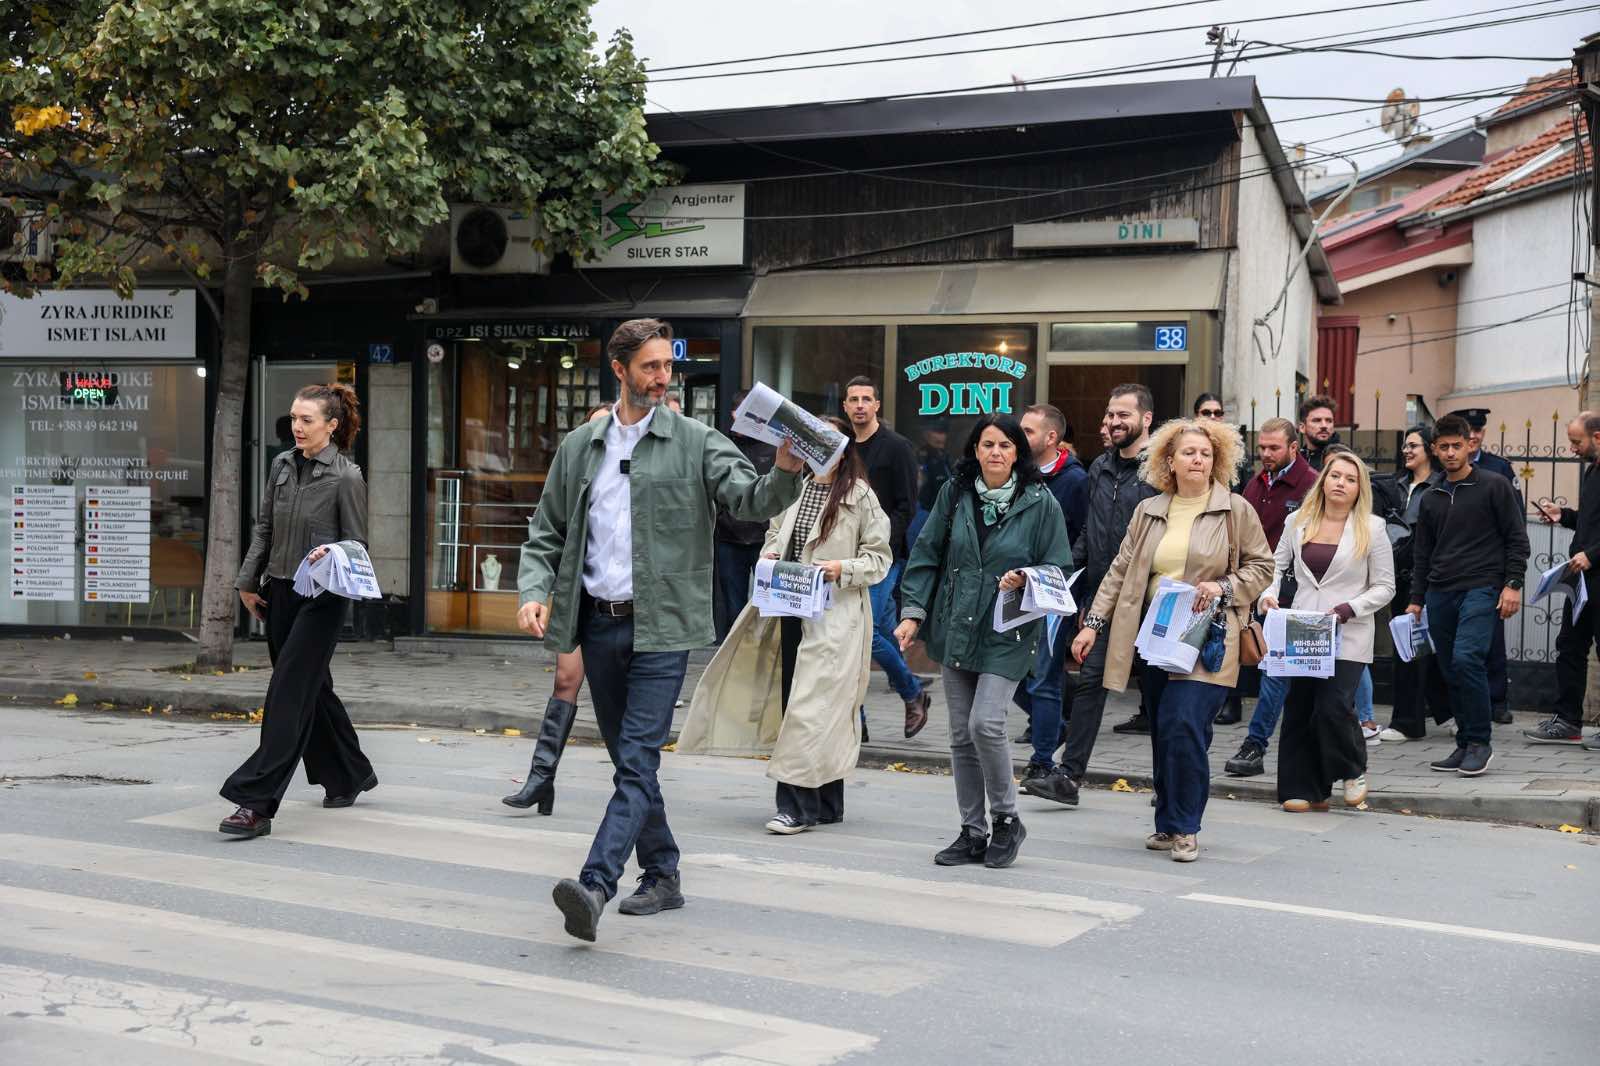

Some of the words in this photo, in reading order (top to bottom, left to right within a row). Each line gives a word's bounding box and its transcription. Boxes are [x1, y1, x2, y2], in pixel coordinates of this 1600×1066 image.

[671, 194, 735, 207] Argjentar
[1117, 223, 1163, 240] DINI
[627, 247, 671, 259] SILVER
[675, 246, 708, 258] STAR
[41, 305, 87, 319] ZYRA
[91, 304, 174, 319] JURIDIKE
[48, 328, 100, 342] ISMET
[105, 327, 167, 342] ISLAMI
[470, 325, 489, 337] ISI
[494, 325, 545, 337] SILVER
[551, 325, 590, 337] STAR
[1158, 328, 1184, 349] 38
[372, 345, 391, 362] 42
[904, 352, 1028, 382] BUREKTORE
[12, 371, 62, 388] ZYRA
[74, 388, 104, 399] OPEN
[918, 382, 1013, 415] DINI
[20, 395, 75, 410] ISMET
[83, 395, 150, 410] ISLAMI
[30, 420, 54, 432] TEL:
[58, 420, 82, 432] +383
[84, 420, 97, 432] 49
[99, 420, 118, 432] 642
[121, 420, 139, 432] 194
